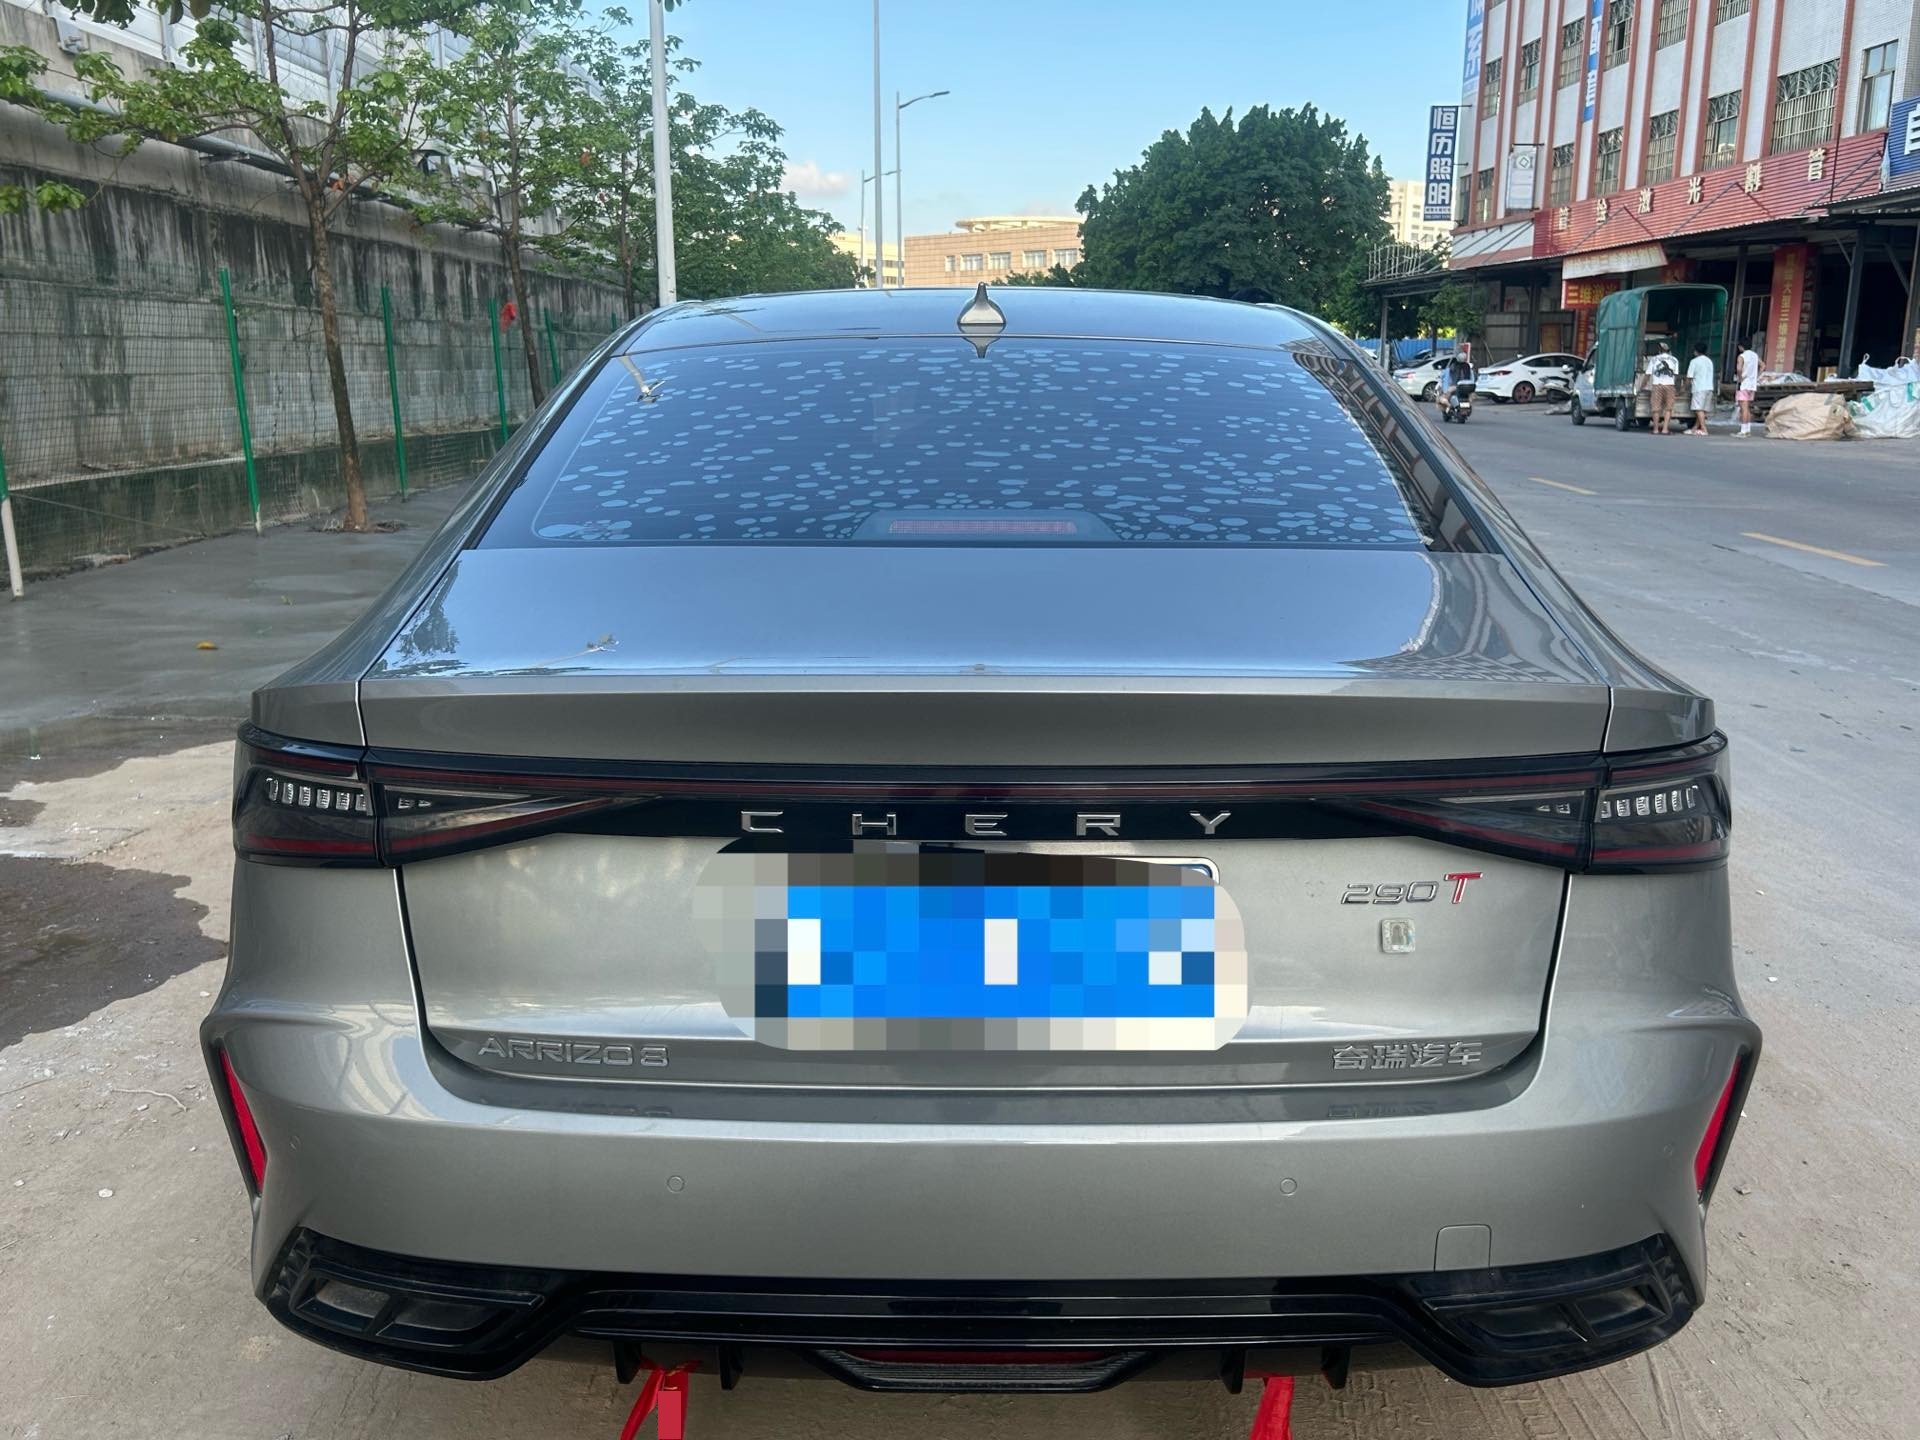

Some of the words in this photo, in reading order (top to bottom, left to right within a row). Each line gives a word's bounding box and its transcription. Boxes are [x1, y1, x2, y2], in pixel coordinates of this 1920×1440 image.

[1427, 107, 1456, 205] 恒历照明
[741, 810, 1231, 836] CHERY
[1341, 872, 1483, 904] 290T
[1332, 1042, 1483, 1070] 奇瑞汽车
